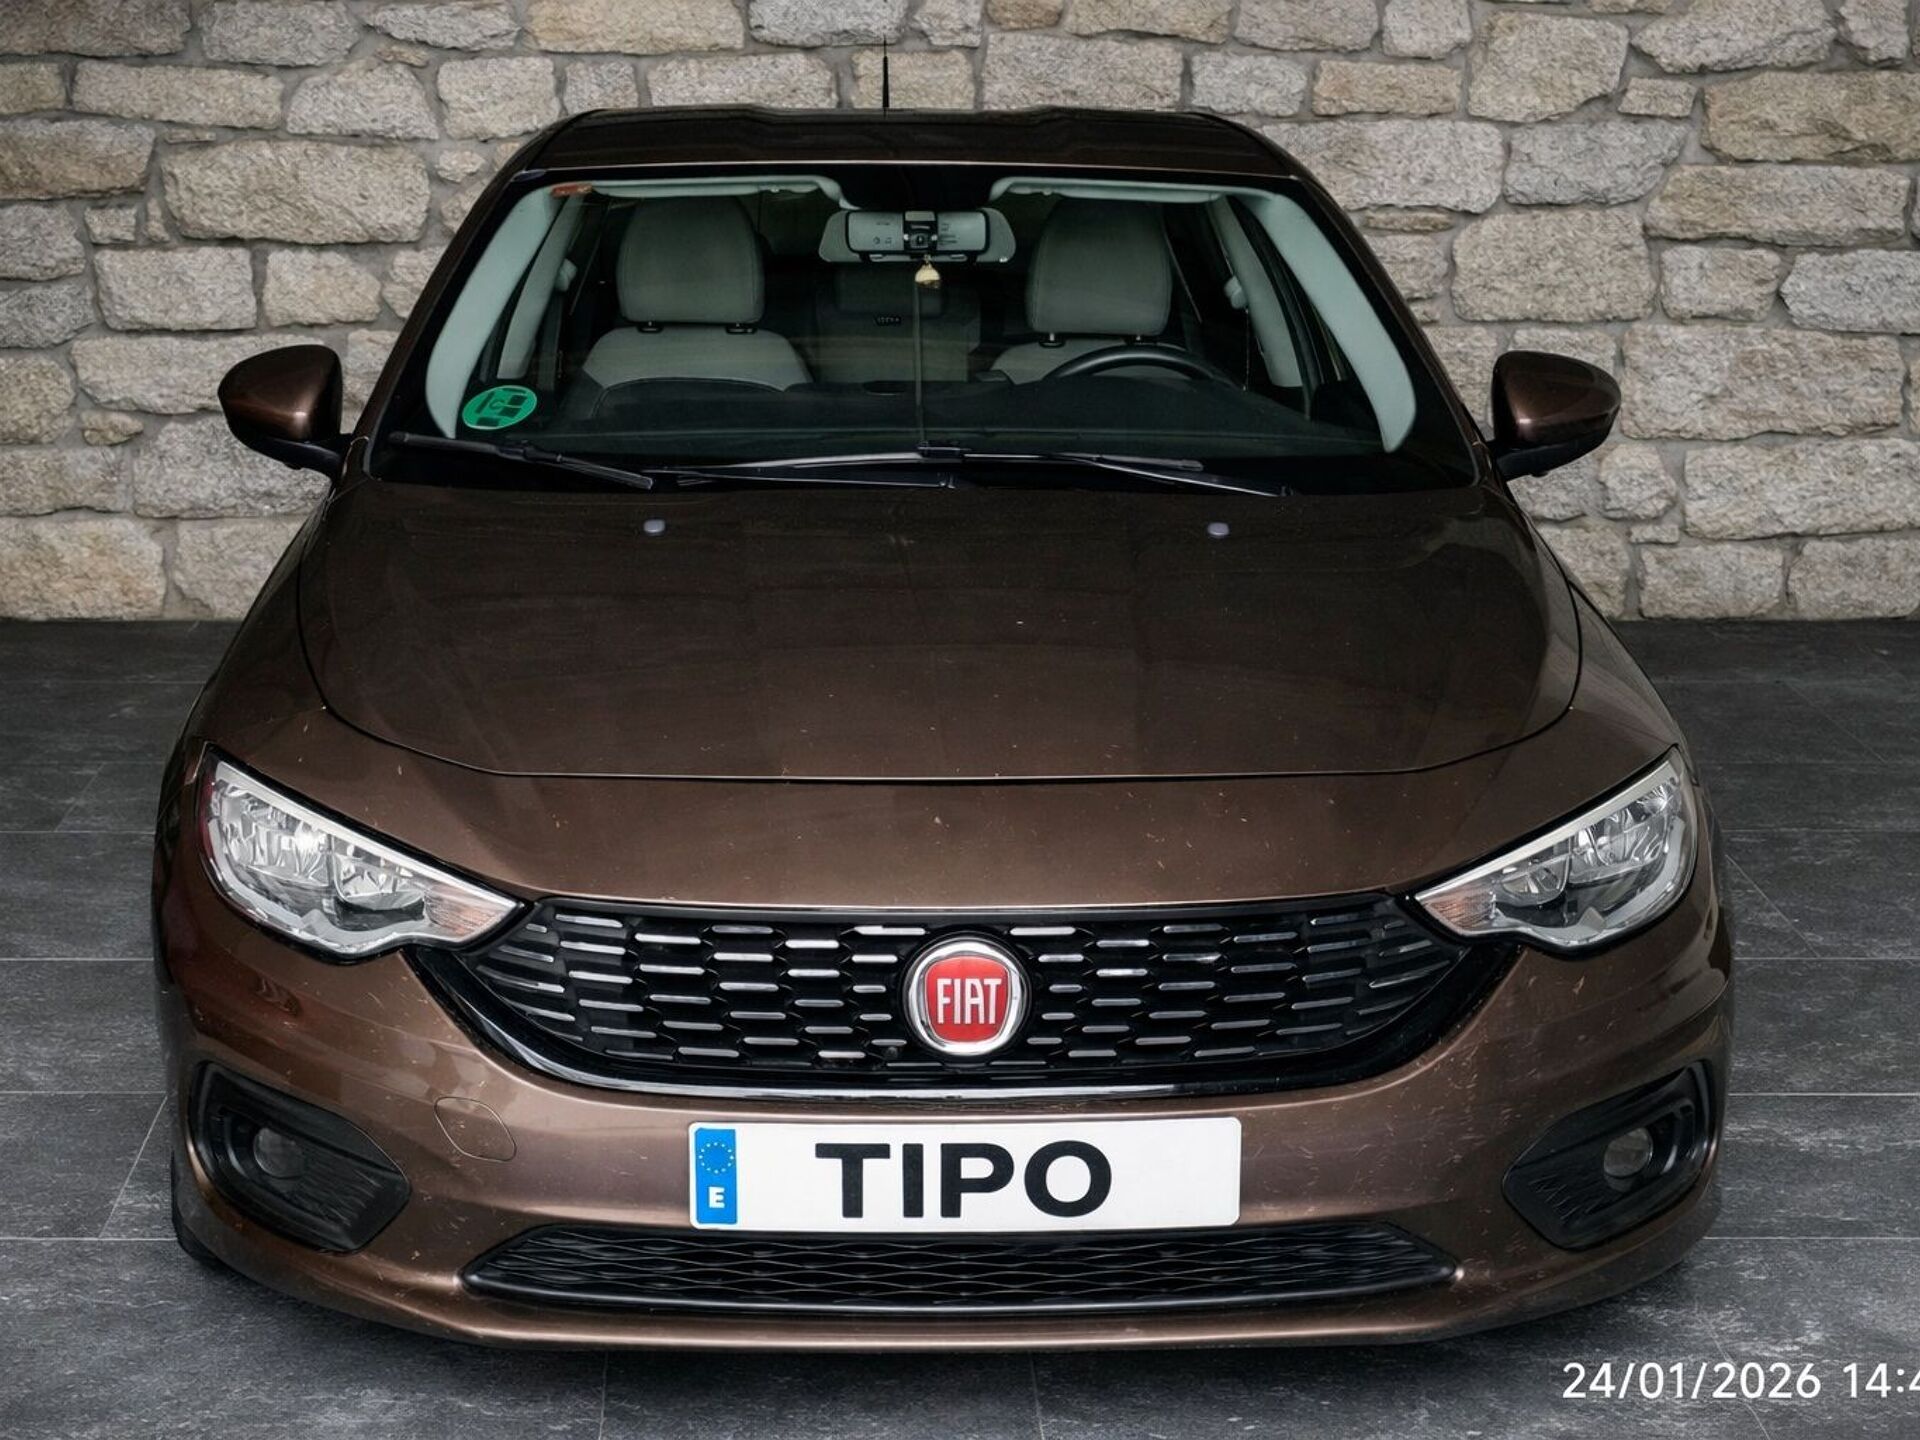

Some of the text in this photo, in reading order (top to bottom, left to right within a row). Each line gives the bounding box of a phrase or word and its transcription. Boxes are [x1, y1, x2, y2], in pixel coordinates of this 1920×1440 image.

[936, 978, 1002, 1025] FIAT
[709, 1186, 725, 1208] E
[815, 1140, 1112, 1218] TIPO
